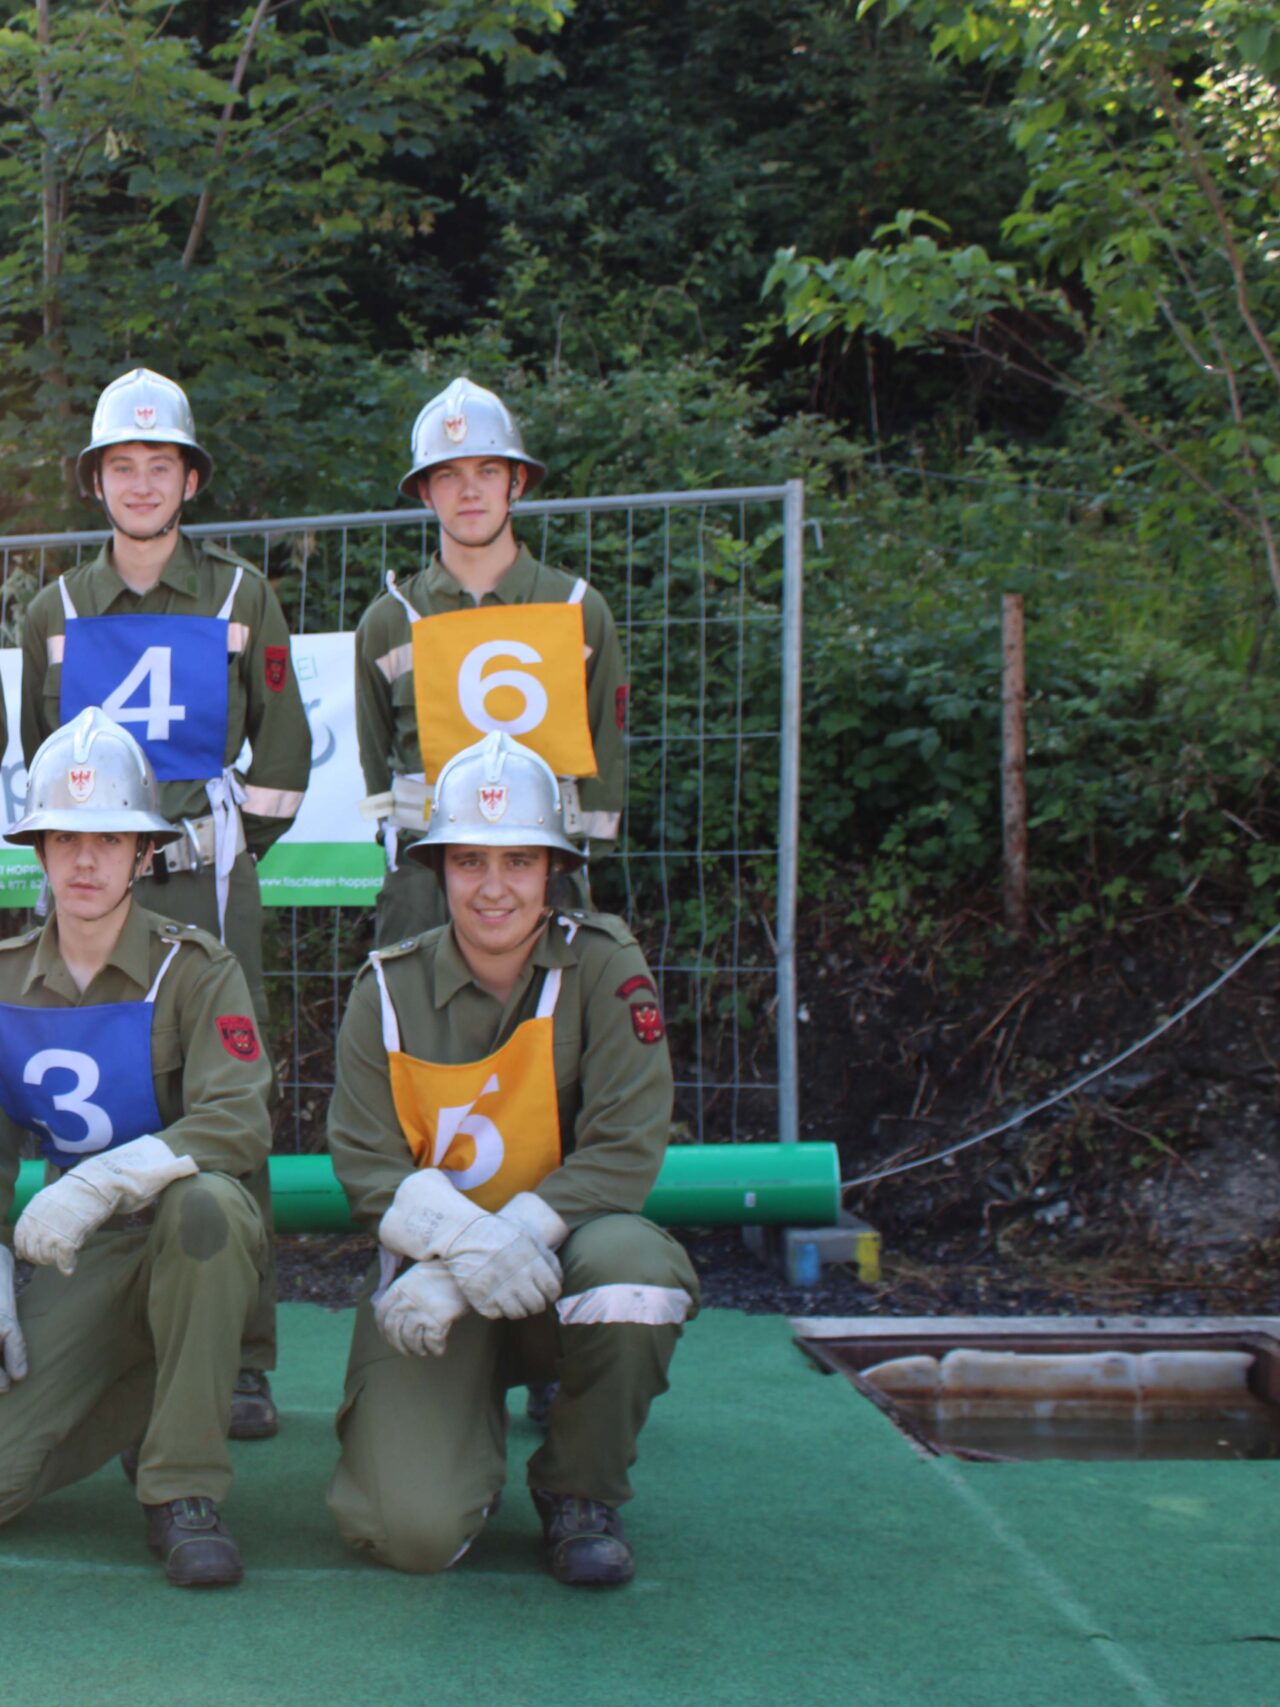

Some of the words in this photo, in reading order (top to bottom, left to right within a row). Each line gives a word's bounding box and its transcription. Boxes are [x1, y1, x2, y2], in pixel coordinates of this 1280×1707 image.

[100, 646, 186, 741] 4
[458, 639, 548, 736] 6
[23, 1048, 113, 1154] 3
[433, 1072, 505, 1190] 5
